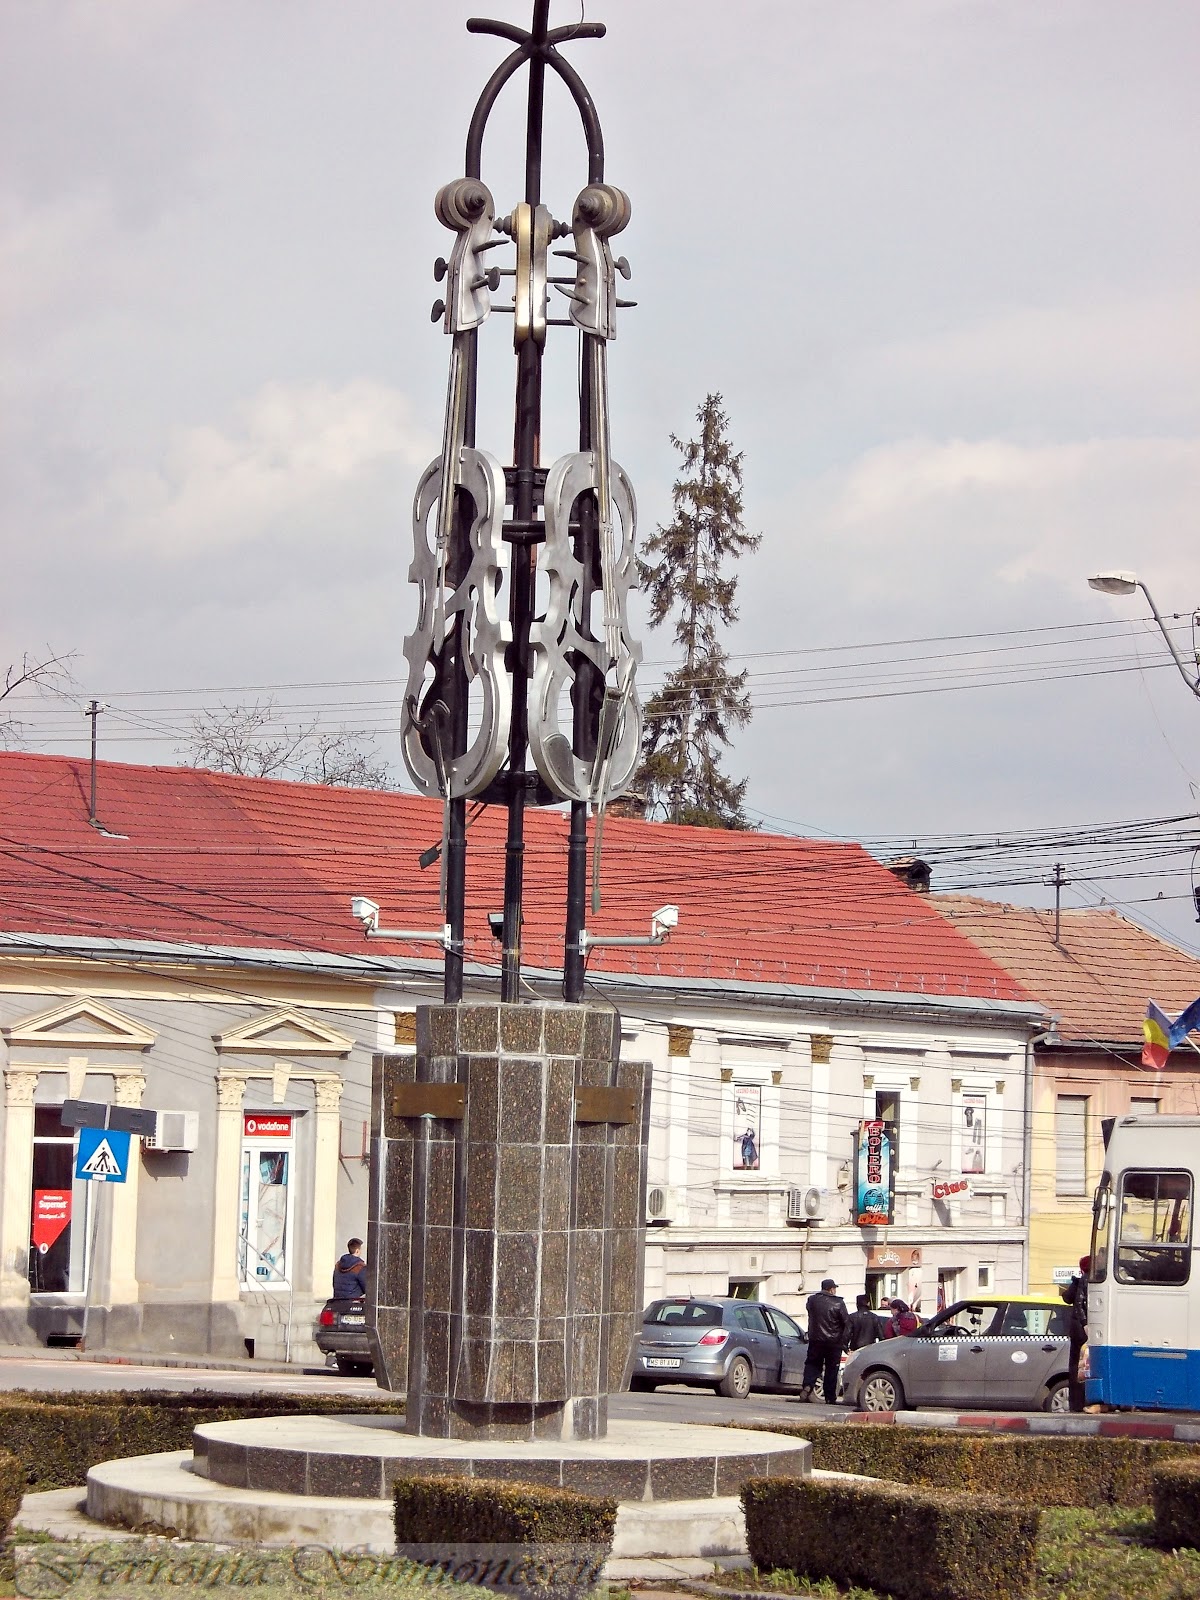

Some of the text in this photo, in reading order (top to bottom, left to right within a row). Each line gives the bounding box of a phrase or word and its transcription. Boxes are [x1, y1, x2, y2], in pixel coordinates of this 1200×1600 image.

[257, 1121, 289, 1131] vodafone
[868, 1126, 881, 1184] BOLERO
[1055, 1270, 1074, 1278] LEGUME
